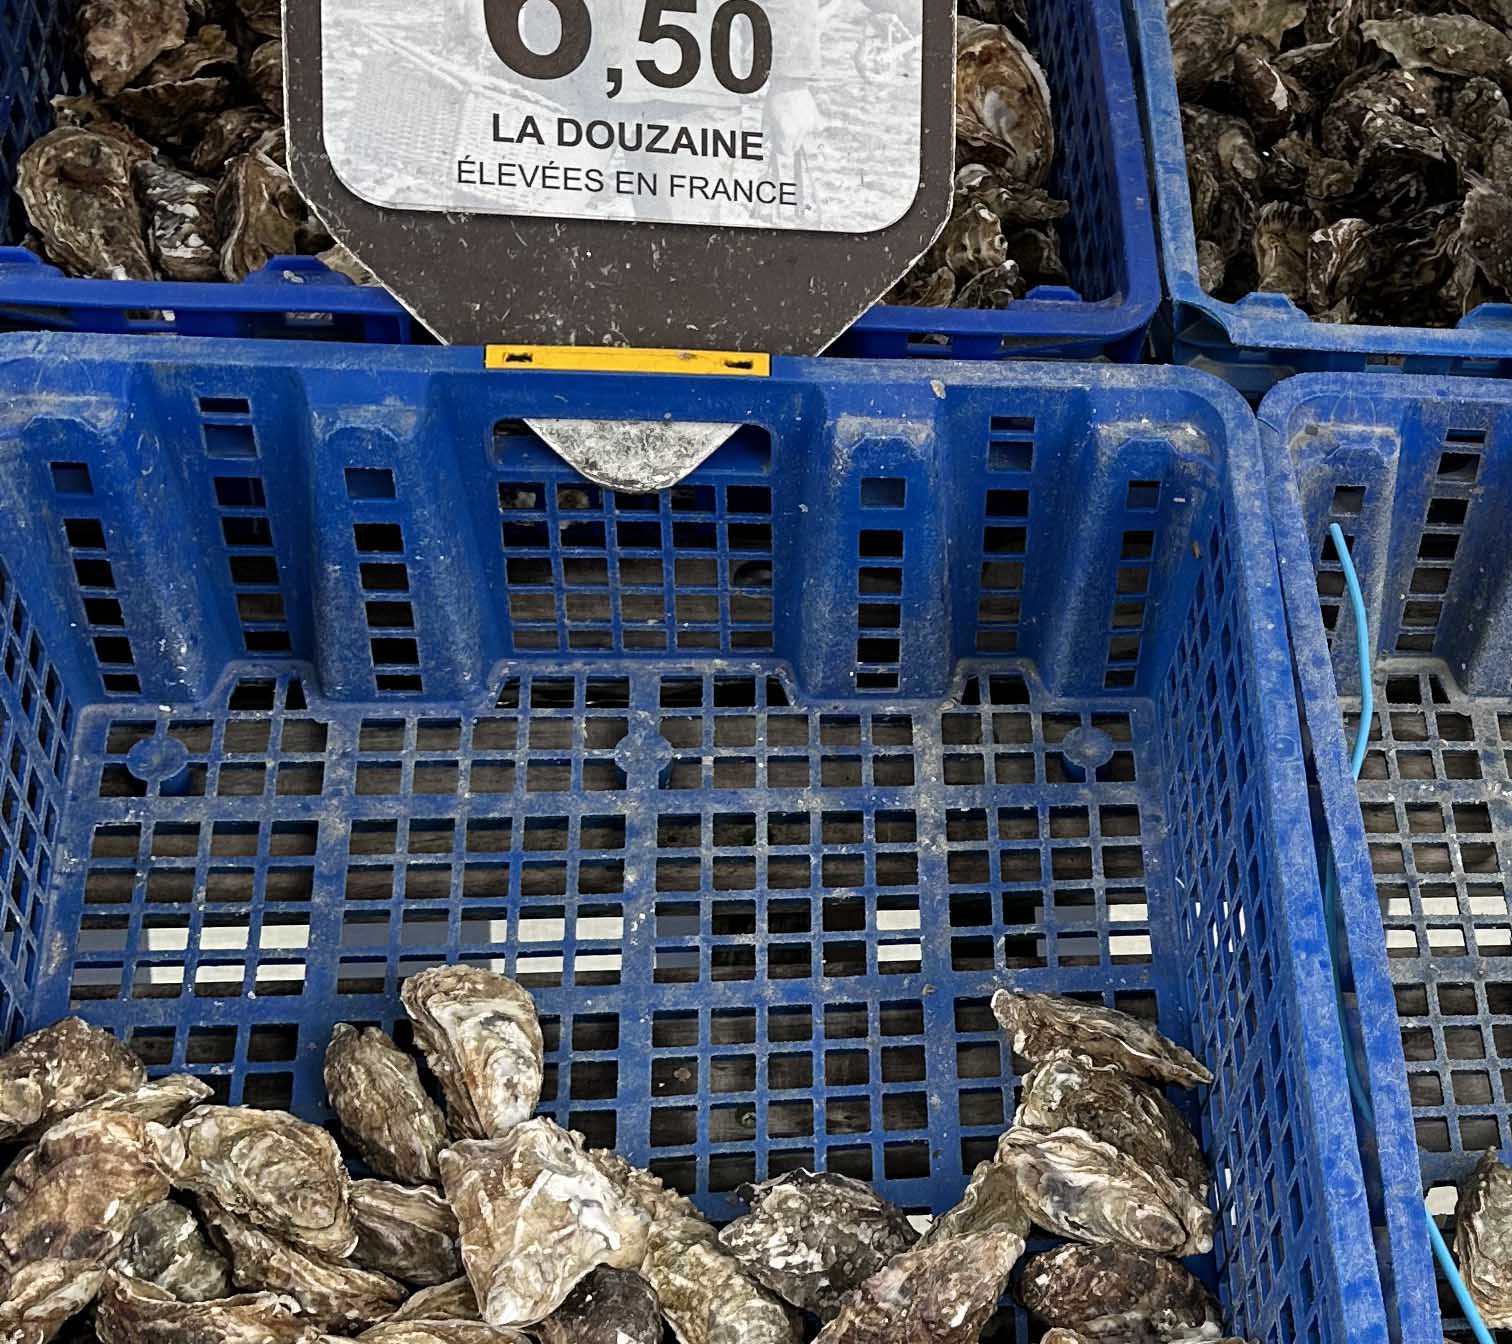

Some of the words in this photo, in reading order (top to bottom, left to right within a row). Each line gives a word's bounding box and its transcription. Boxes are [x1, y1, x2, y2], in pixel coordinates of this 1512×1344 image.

[493, 113, 545, 145] LA
[558, 118, 763, 161] DOUZAINE
[458, 155, 604, 192] ÉLEVÉES
[616, 171, 656, 196] EN
[670, 175, 797, 205] FRANCE
